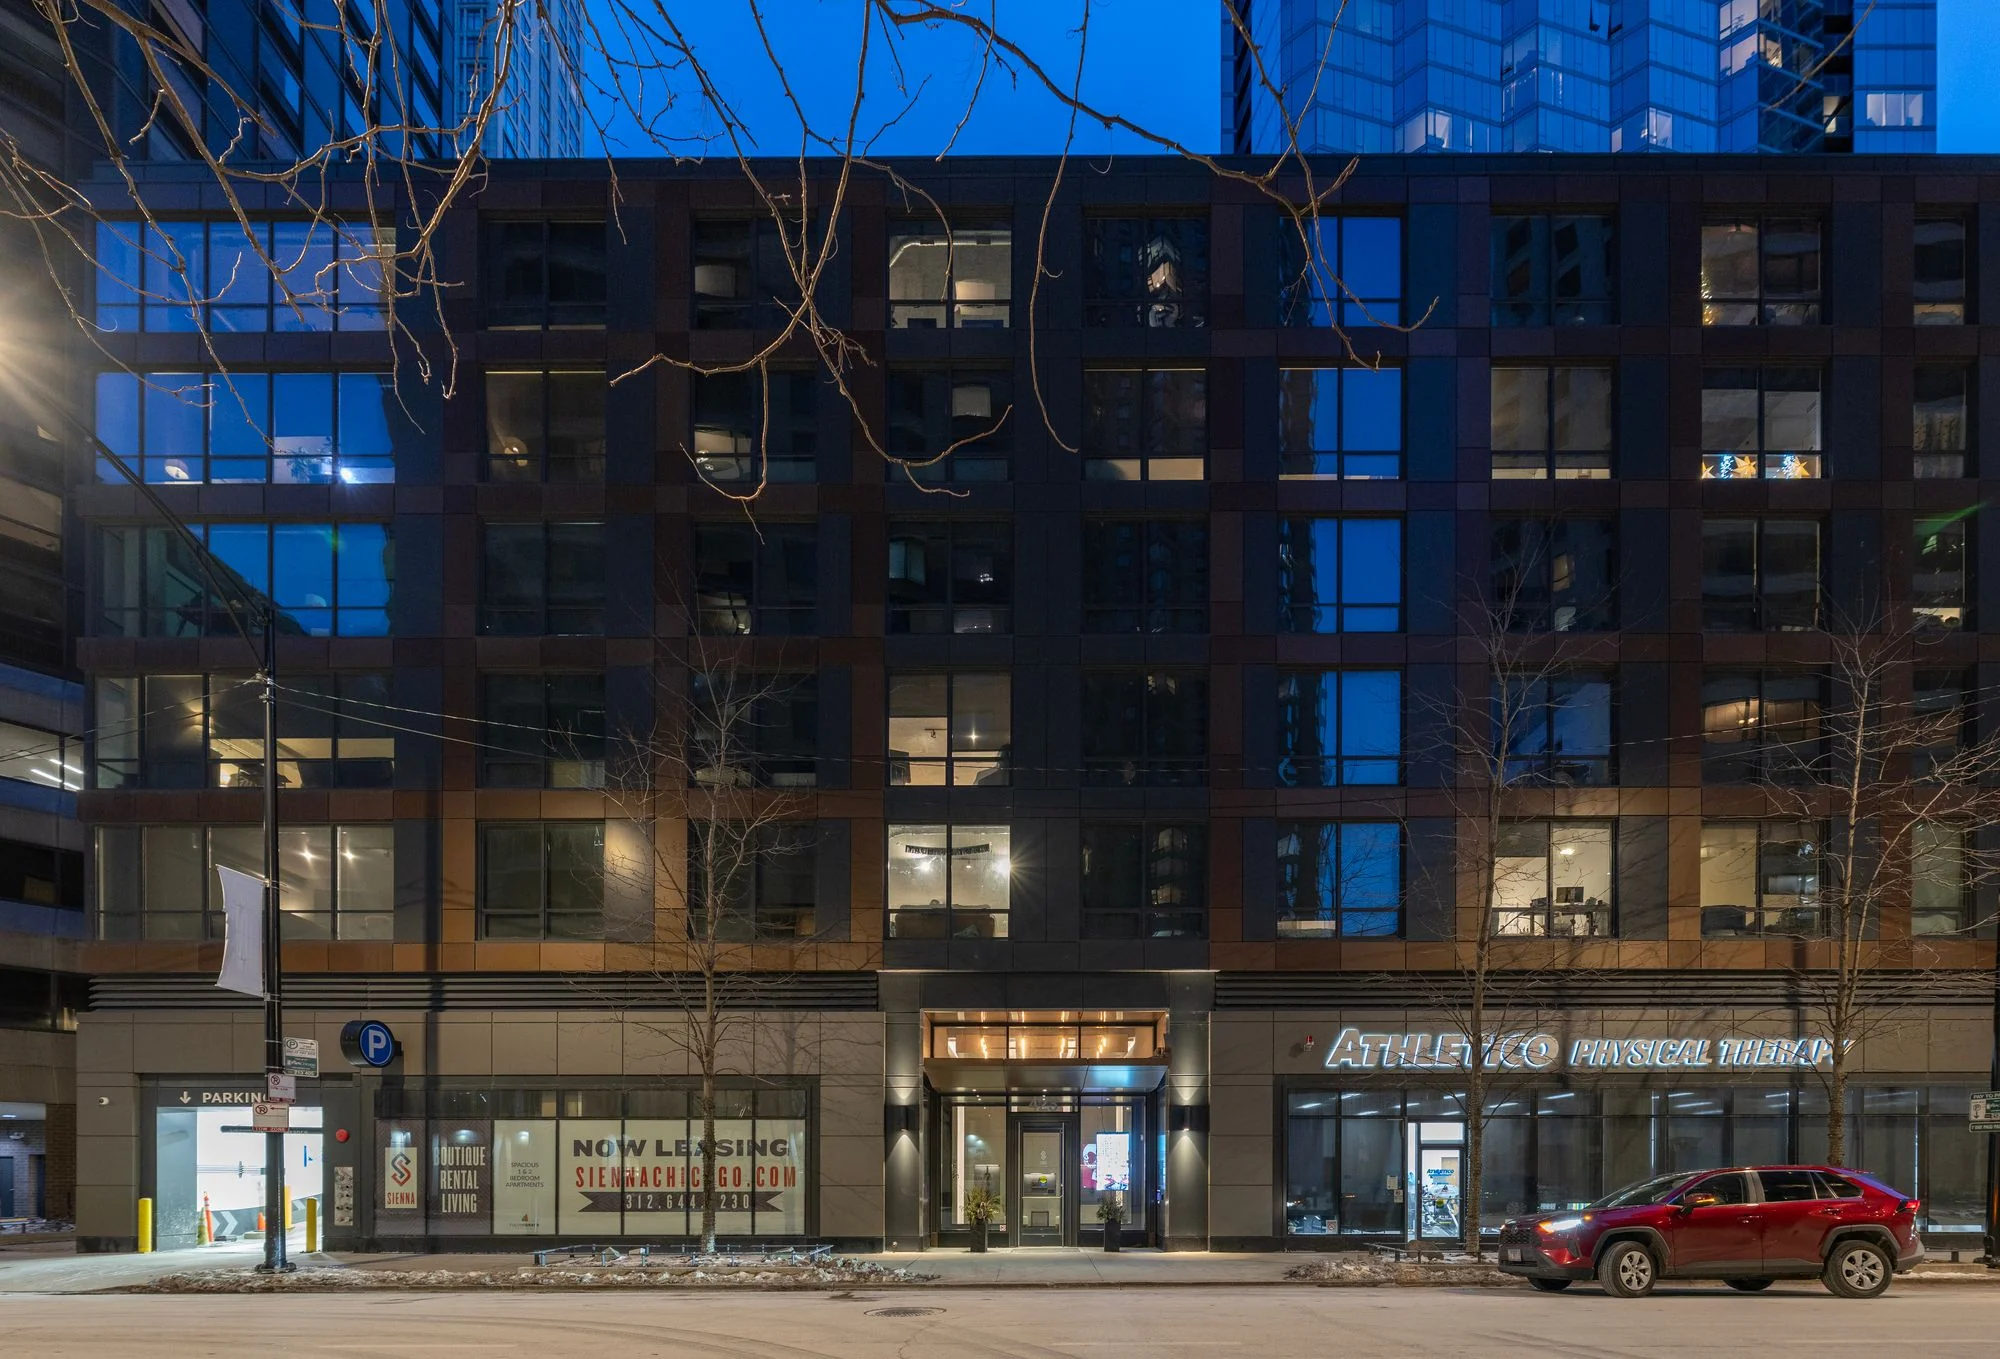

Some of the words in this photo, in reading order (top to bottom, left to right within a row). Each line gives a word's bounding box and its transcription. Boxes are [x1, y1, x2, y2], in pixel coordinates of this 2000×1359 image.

[368, 1029, 387, 1058] P
[1326, 1028, 1559, 1068] ATHLETICO
[1569, 1038, 1713, 1067] PHYSICAL
[433, 1146, 486, 1166] BOUTIQUE
[573, 1139, 647, 1157] NOW
[440, 1170, 479, 1190] RENTAL
[575, 1166, 796, 1188] SIENNACHICGO.COM
[387, 1192, 415, 1205] SIENNA
[442, 1194, 477, 1213] LIVING
[626, 1194, 749, 1209] 312.644.230
